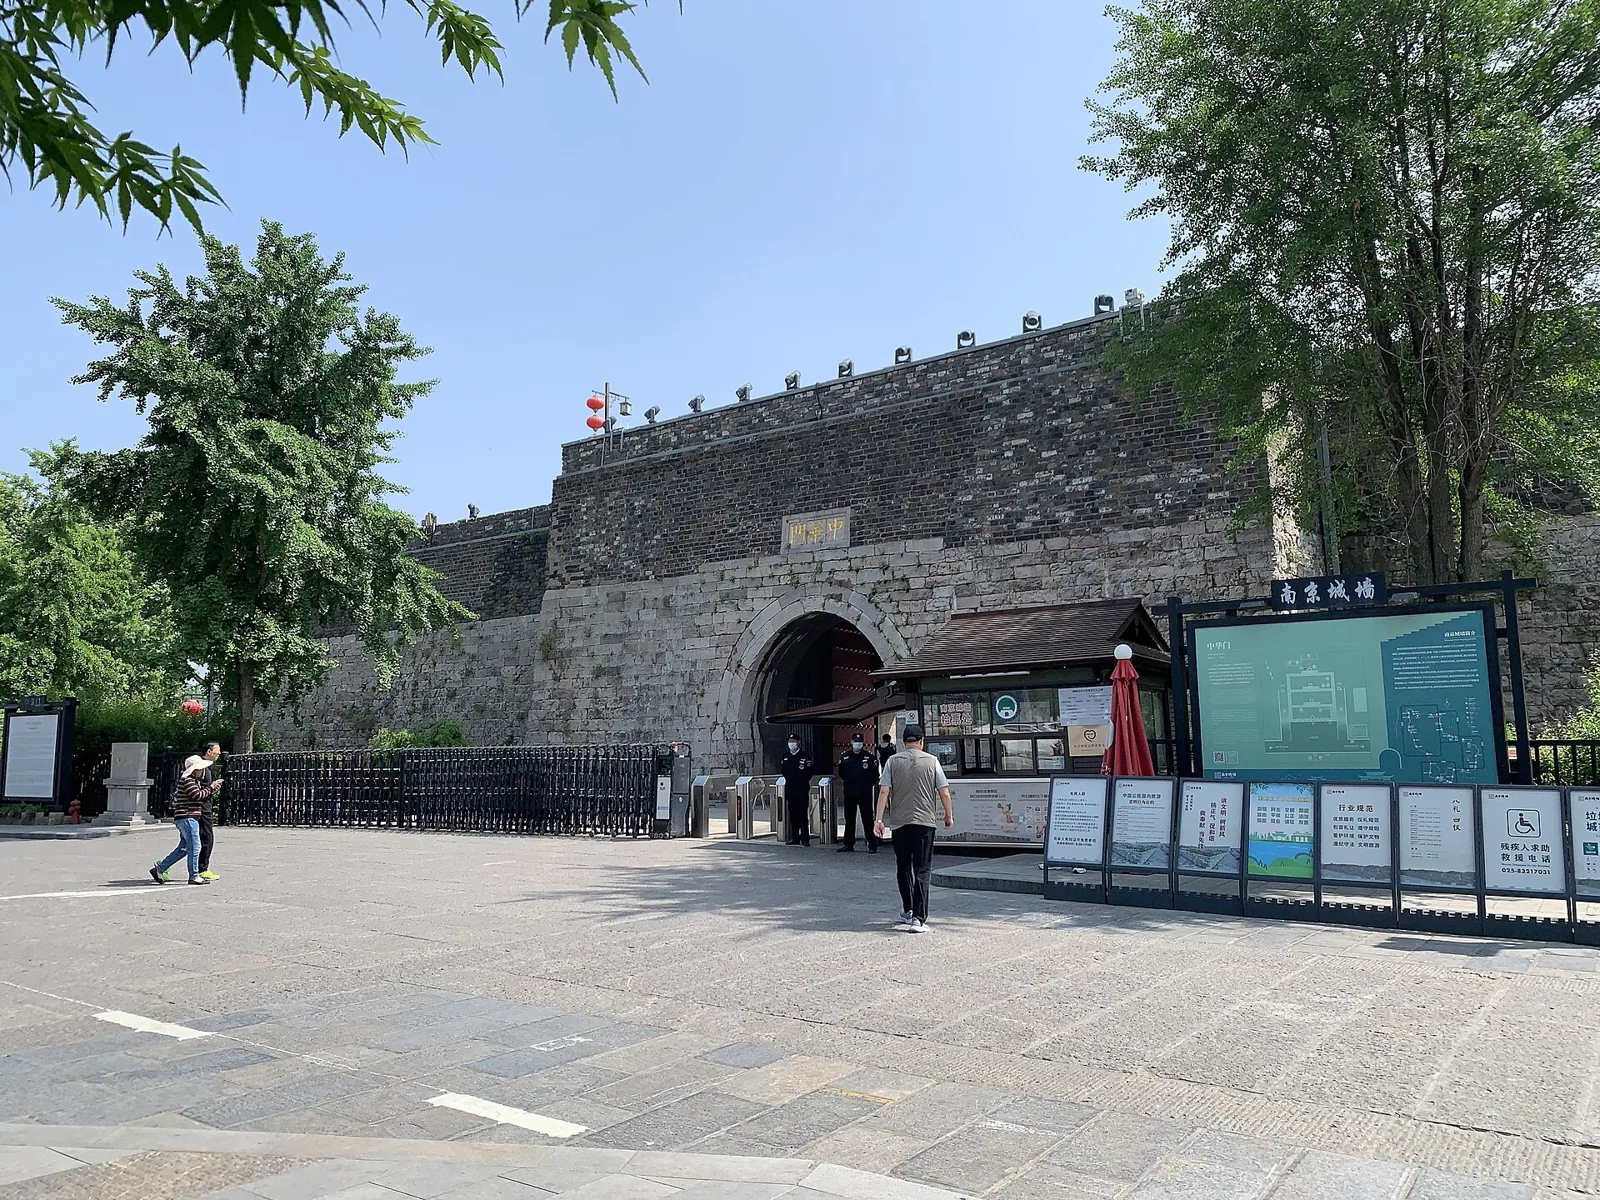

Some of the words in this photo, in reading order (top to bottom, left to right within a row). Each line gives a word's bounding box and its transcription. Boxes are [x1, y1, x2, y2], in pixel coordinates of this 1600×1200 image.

[1280, 577, 1375, 604] 南京城墙
[1338, 804, 1374, 812] 行业规范
[1452, 799, 1461, 812] 八礼
[1500, 843, 1550, 852] 残疾人求助
[1501, 853, 1551, 863] 救援电话
